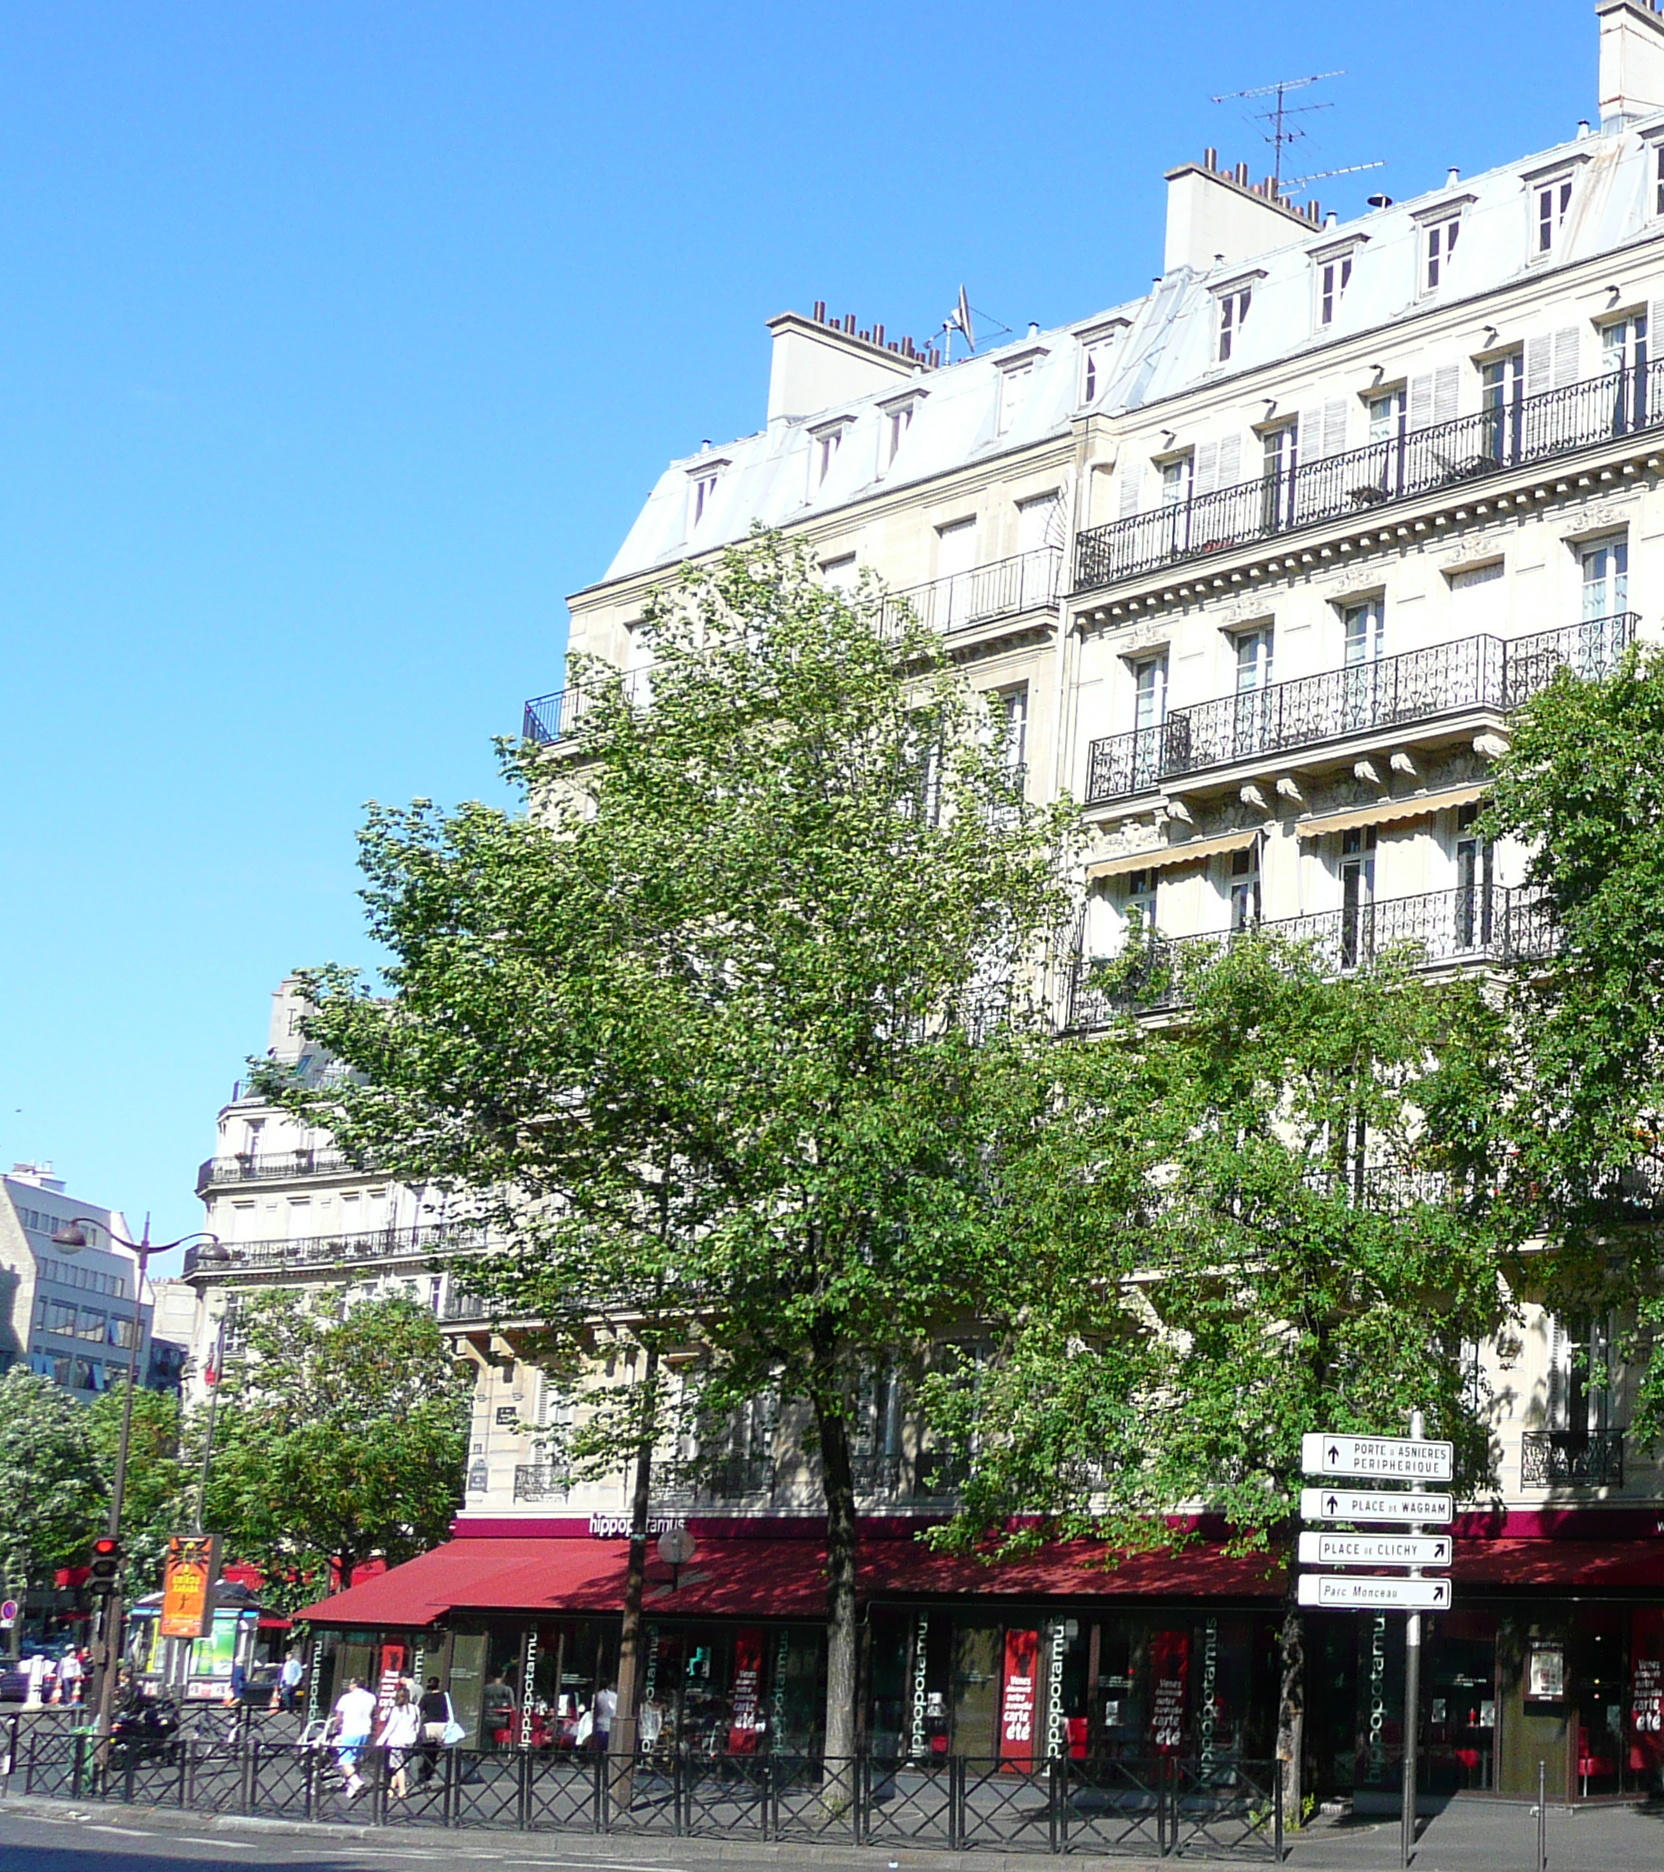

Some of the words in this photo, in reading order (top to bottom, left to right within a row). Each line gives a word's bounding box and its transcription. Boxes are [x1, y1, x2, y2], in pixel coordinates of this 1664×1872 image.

[1354, 1443, 1387, 1456] PORTE
[1353, 1458, 1440, 1474] PERIPHERIQUE
[1351, 1500, 1385, 1512] PLACE
[1401, 1502, 1446, 1514] WAGRAM
[589, 1512, 685, 1537] hippoptamus
[1324, 1543, 1360, 1555] PLACE
[1377, 1544, 1418, 1556] CLICHY
[1323, 1585, 1347, 1597] Parc
[1352, 1586, 1398, 1598] Monceau
